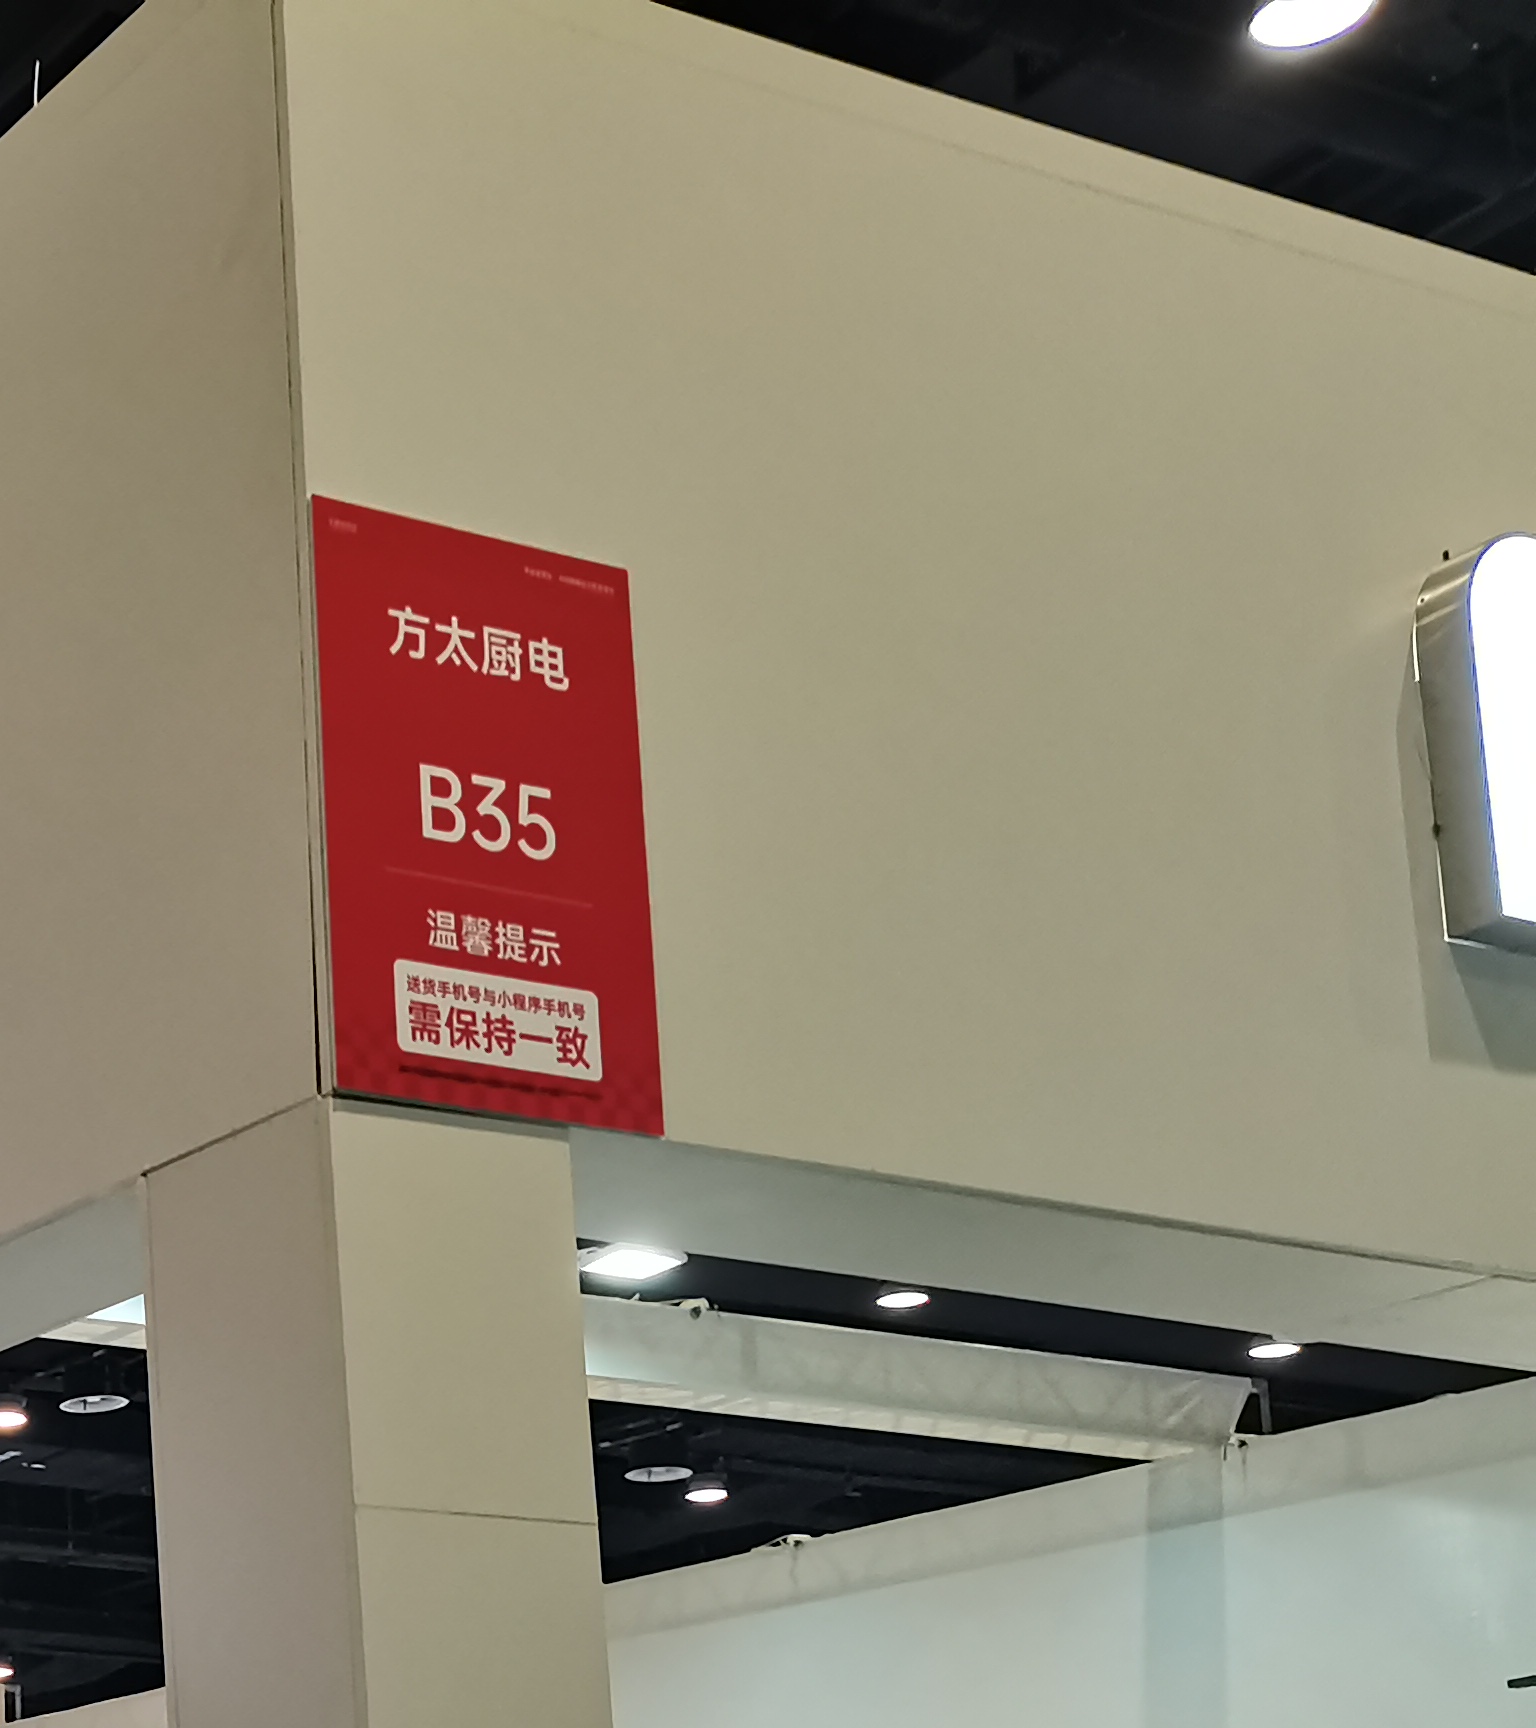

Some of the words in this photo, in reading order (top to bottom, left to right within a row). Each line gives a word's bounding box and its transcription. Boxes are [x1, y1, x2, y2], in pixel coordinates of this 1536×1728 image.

[387, 605, 570, 691] 方太厨电
[418, 763, 557, 861] B35
[426, 909, 562, 967] 温馨提示
[406, 973, 586, 1021] 送货手机号与小程序手机号
[408, 999, 591, 1070] 需保持一致
